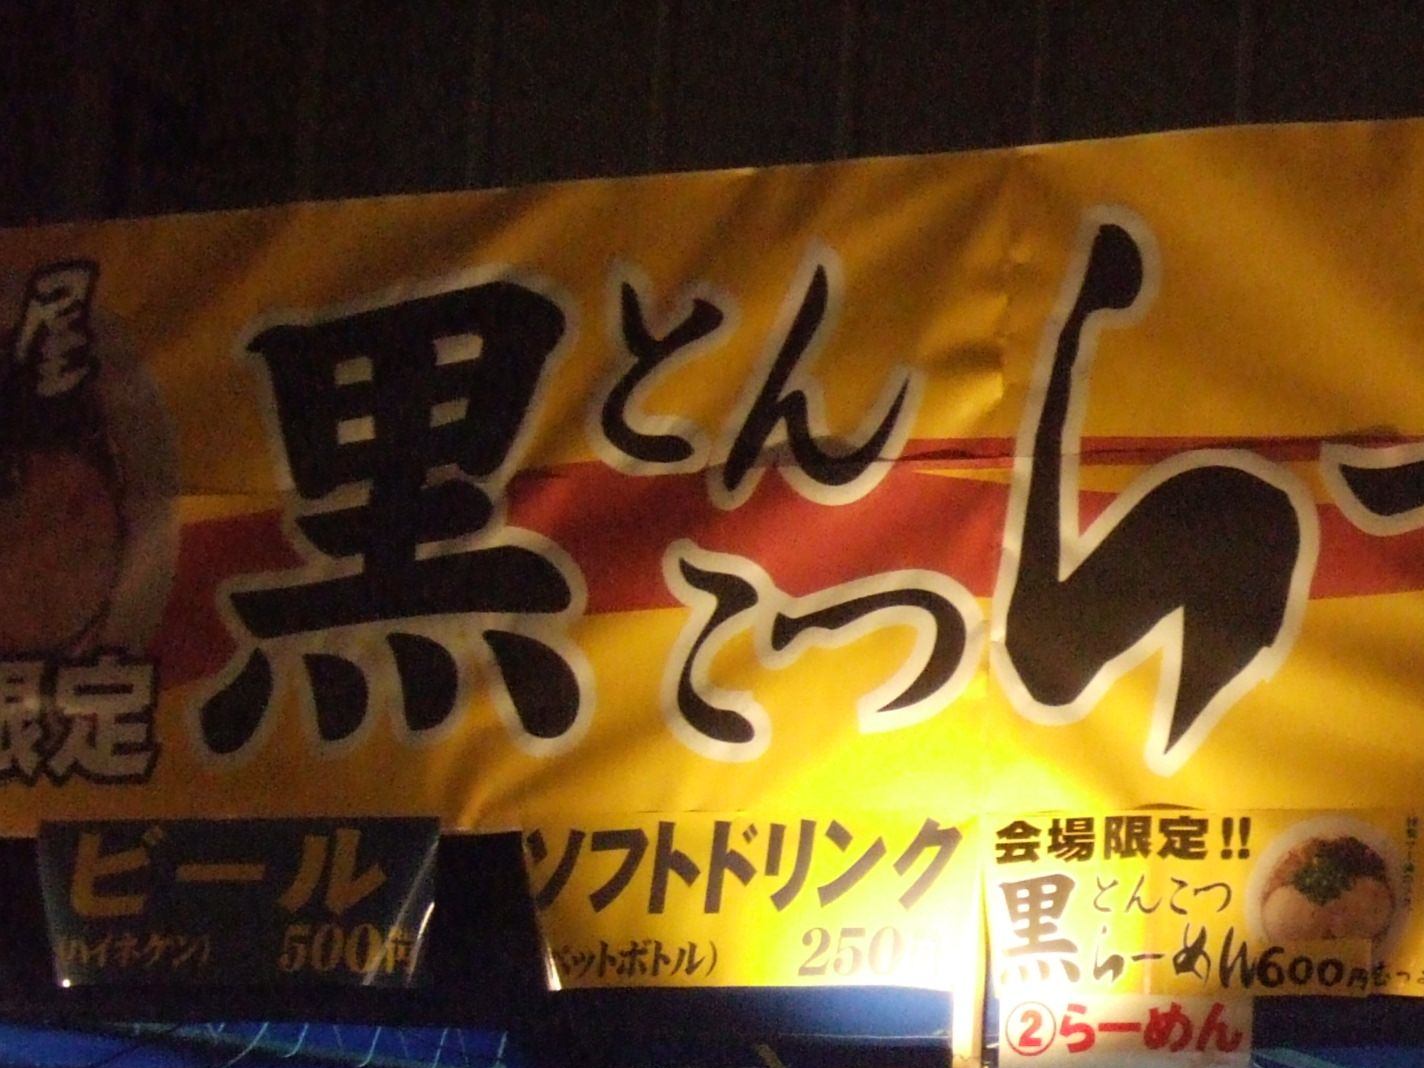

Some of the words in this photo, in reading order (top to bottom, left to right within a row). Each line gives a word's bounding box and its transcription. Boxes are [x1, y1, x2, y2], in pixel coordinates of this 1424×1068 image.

[197, 276, 585, 757] 黒
[69, 825, 388, 917] ビール
[526, 818, 963, 914] ソフトドリンク
[995, 815, 1252, 864] 会場限定!!
[999, 873, 1082, 984] 黒
[1092, 874, 1233, 916] とんこつ
[552, 938, 718, 979] ペットボトル)
[798, 926, 940, 978] 250
[1092, 922, 1262, 989] らーめん
